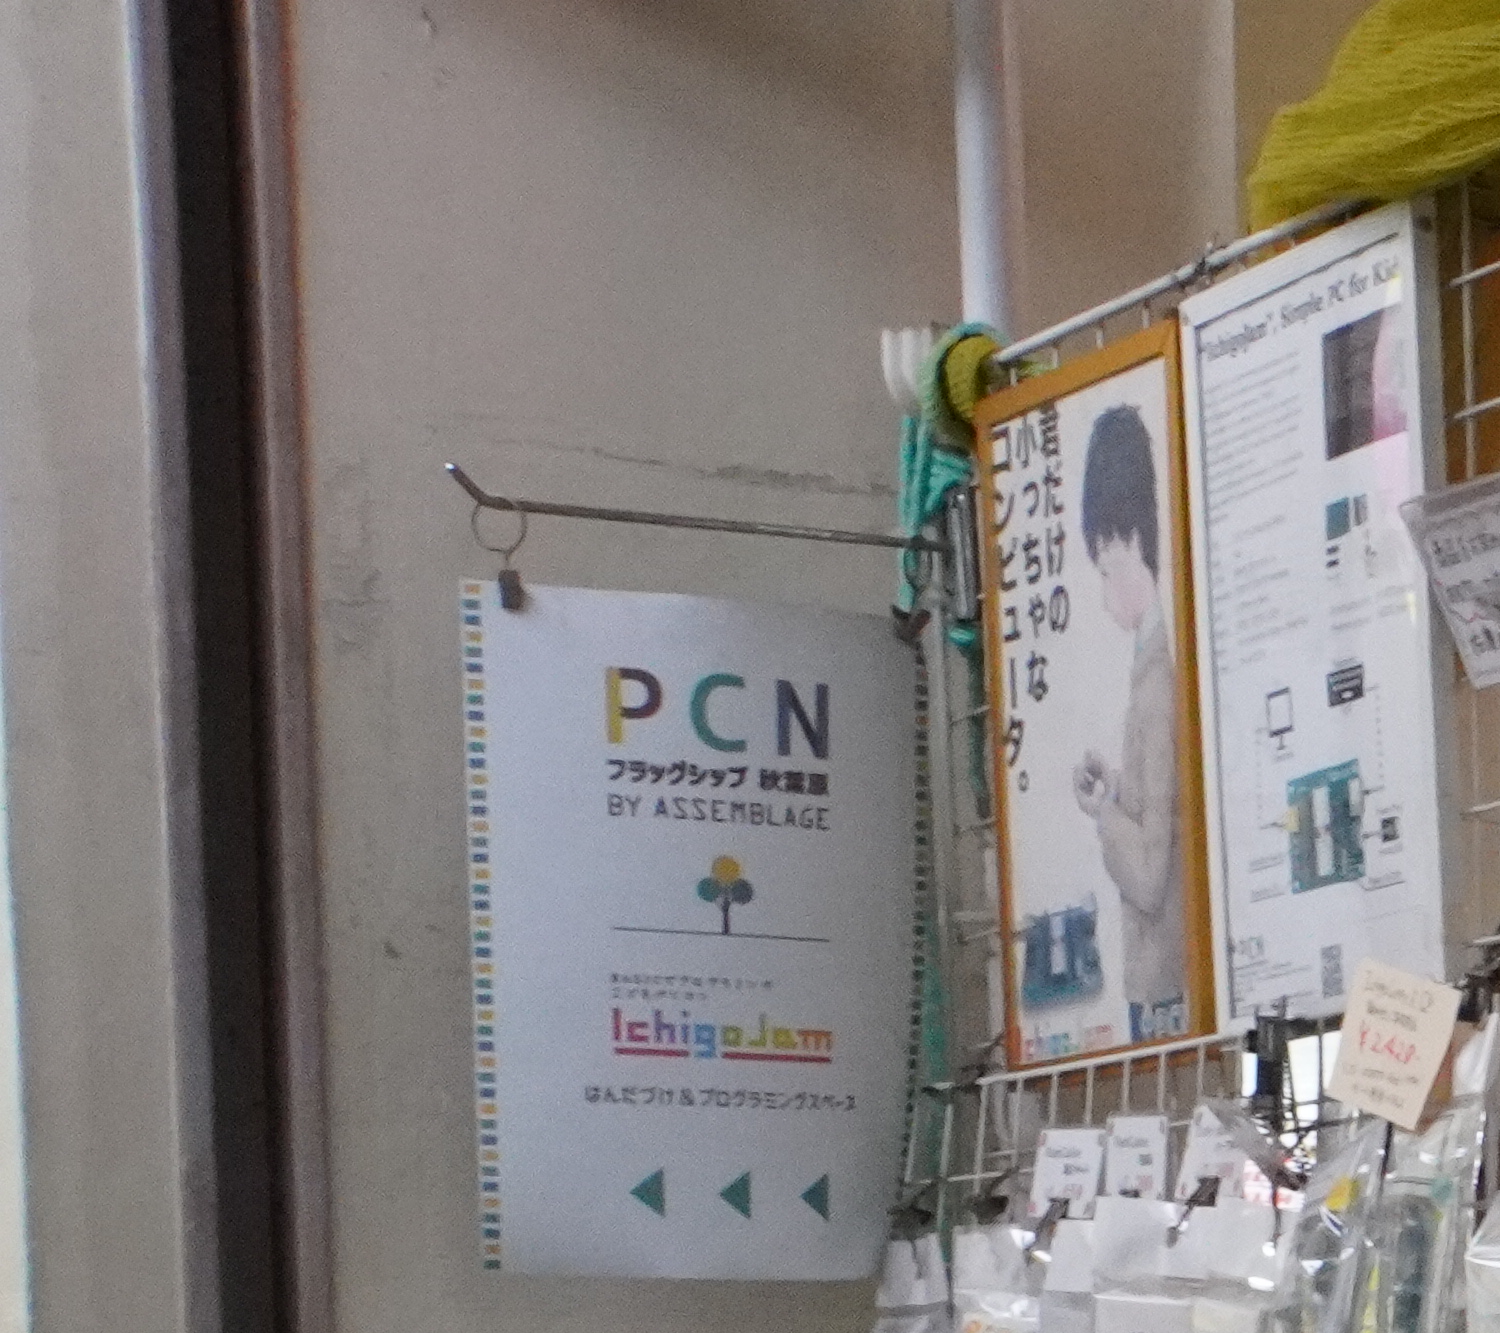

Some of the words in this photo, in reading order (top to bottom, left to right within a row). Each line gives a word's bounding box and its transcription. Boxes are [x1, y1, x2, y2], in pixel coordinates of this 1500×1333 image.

[606, 666, 831, 760] PCN
[608, 795, 643, 819] BY
[654, 799, 832, 832] ASSEMBLAGE
[611, 1006, 834, 1061] IchigoJam
